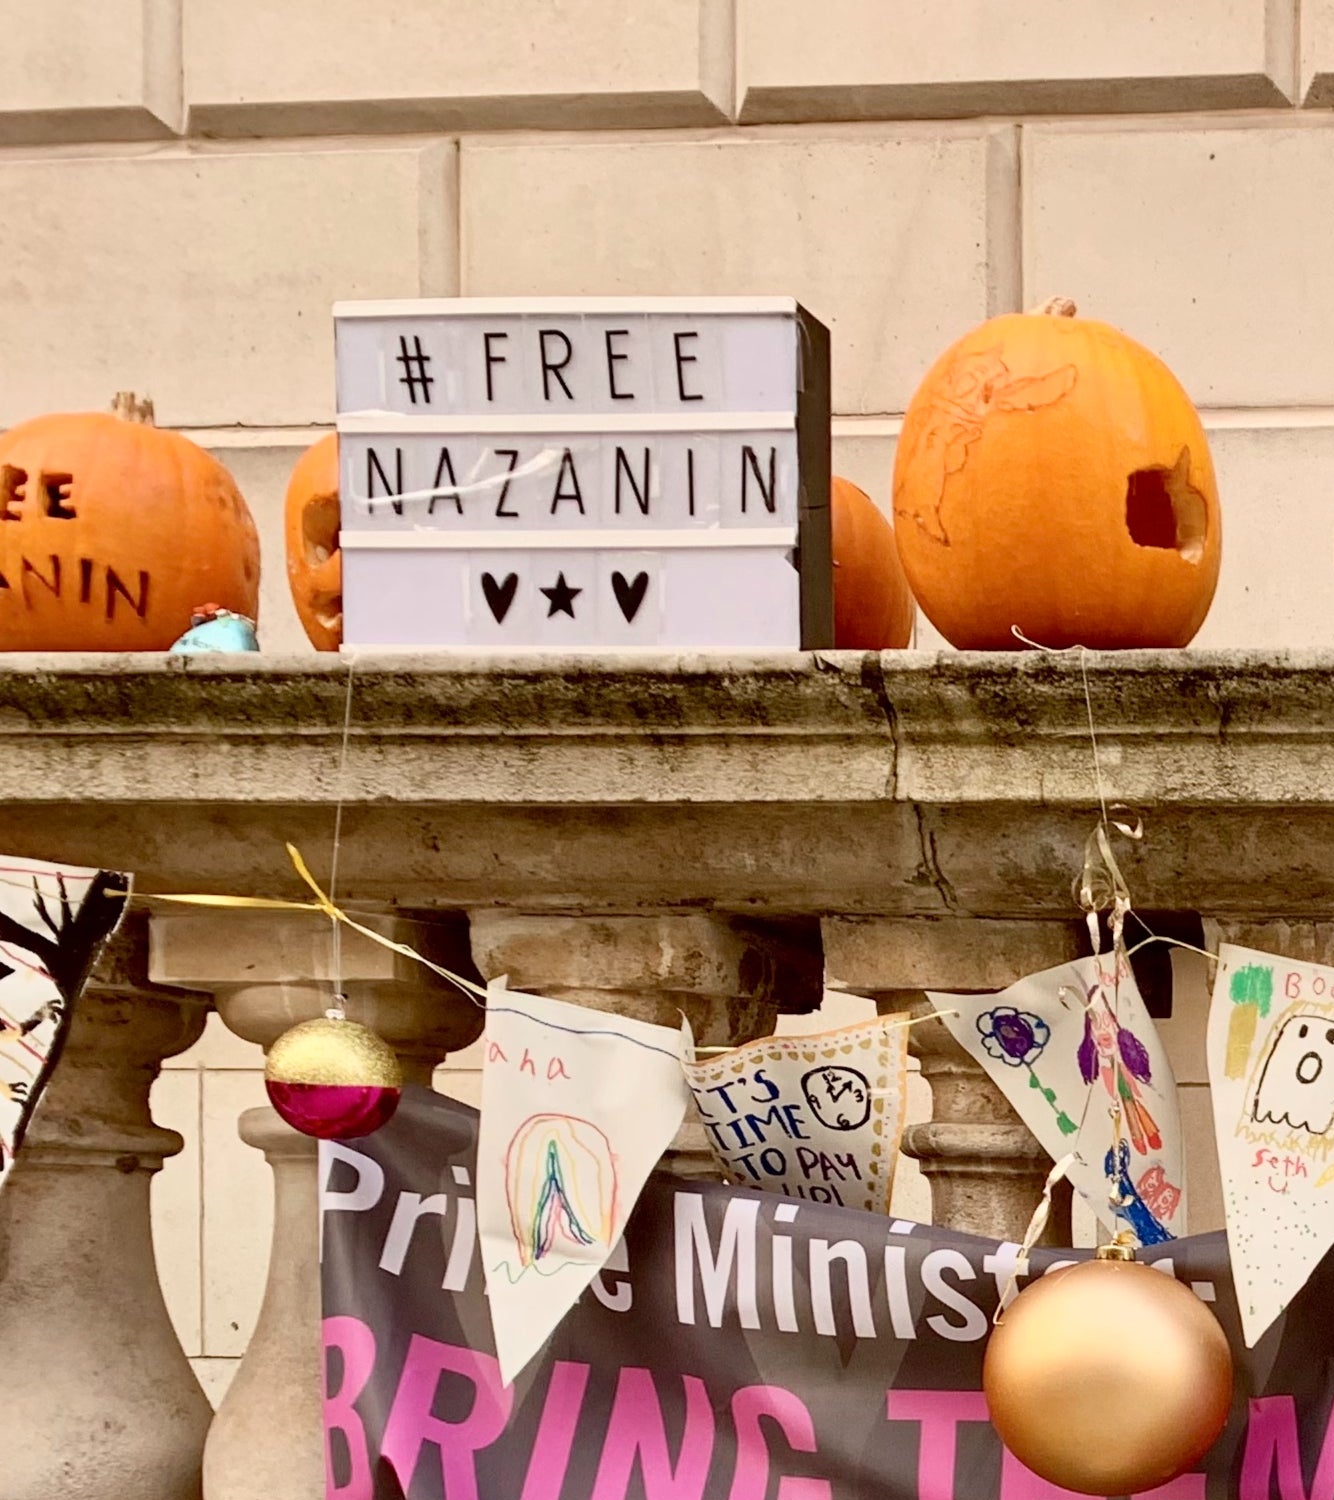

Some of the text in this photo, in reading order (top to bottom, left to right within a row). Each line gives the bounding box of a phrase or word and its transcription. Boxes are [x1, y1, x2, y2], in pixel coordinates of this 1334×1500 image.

[484, 329, 704, 402] FREE
[367, 445, 777, 517] NAZANIN
[704, 1104, 811, 1150] TIME
[732, 1147, 787, 1181] TO
[1251, 1148, 1308, 1178] Seth
